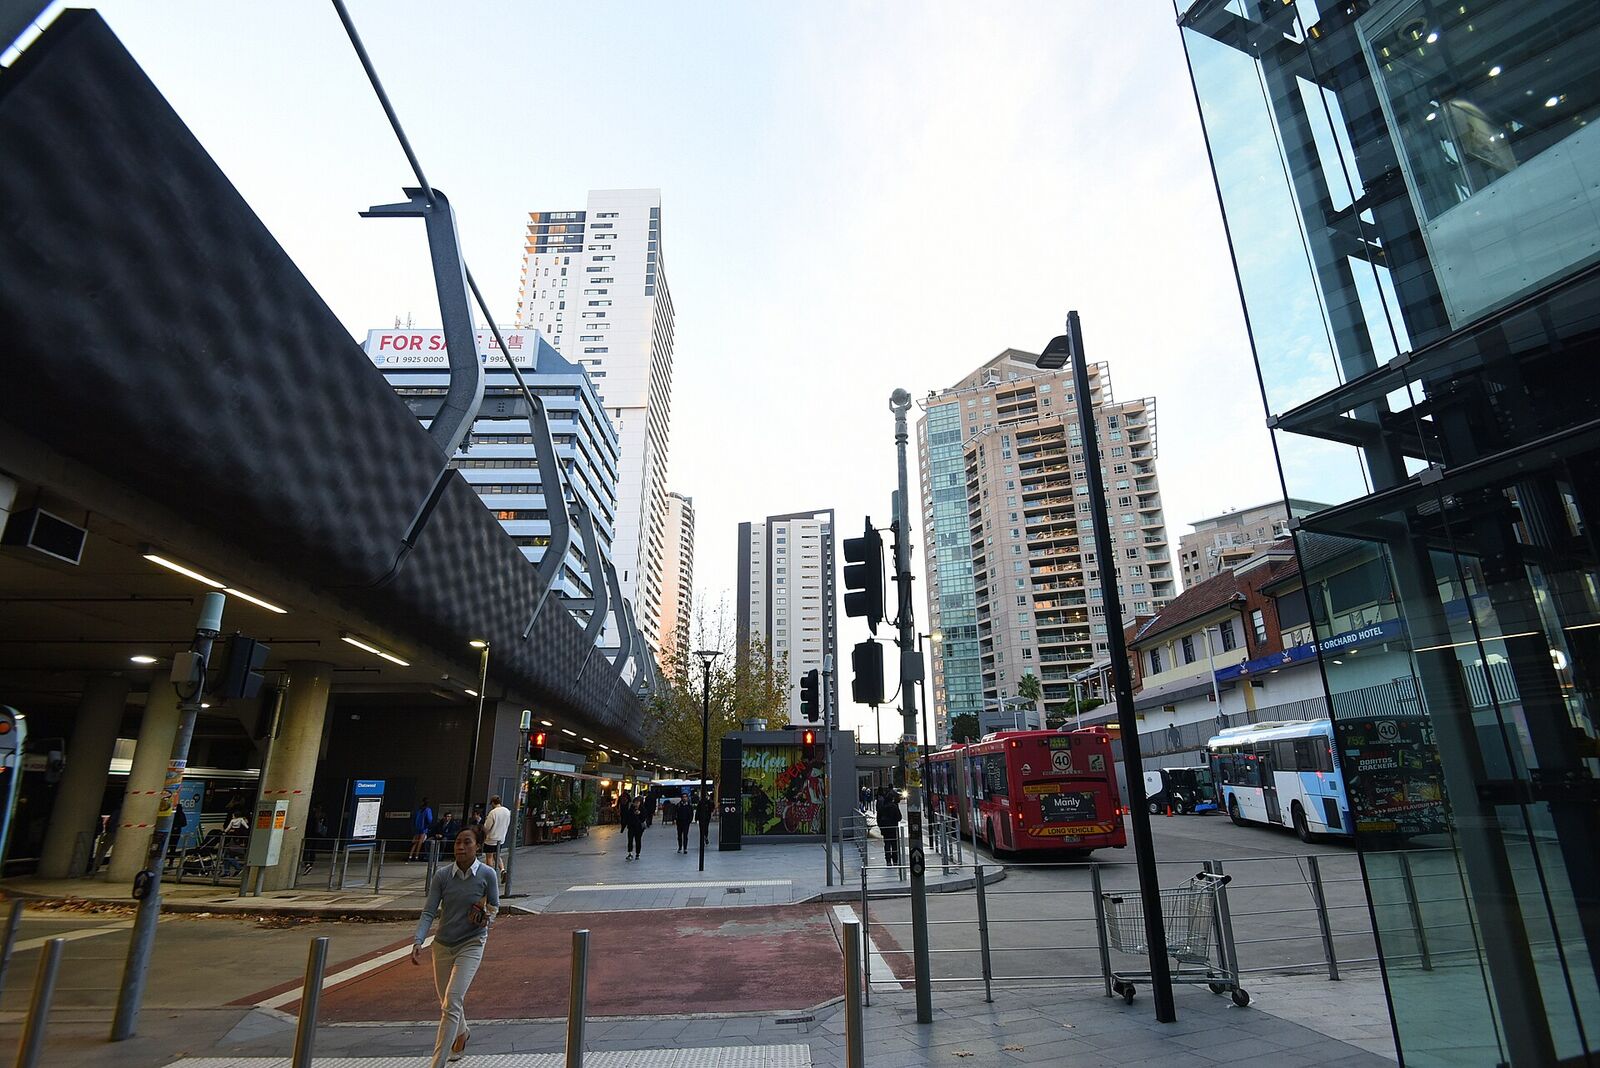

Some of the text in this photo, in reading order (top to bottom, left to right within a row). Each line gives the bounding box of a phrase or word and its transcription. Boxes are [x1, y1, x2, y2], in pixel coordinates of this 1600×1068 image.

[380, 335, 423, 351] FOR
[1310, 626, 1383, 653] TE ORCHARD HOTEL
[1381, 726, 1396, 735] 40
[1055, 756, 1069, 766] 40
[1359, 757, 1393, 766] DORITOS
[1358, 762, 1398, 771] CRACKERS
[1054, 798, 1080, 808] Manly
